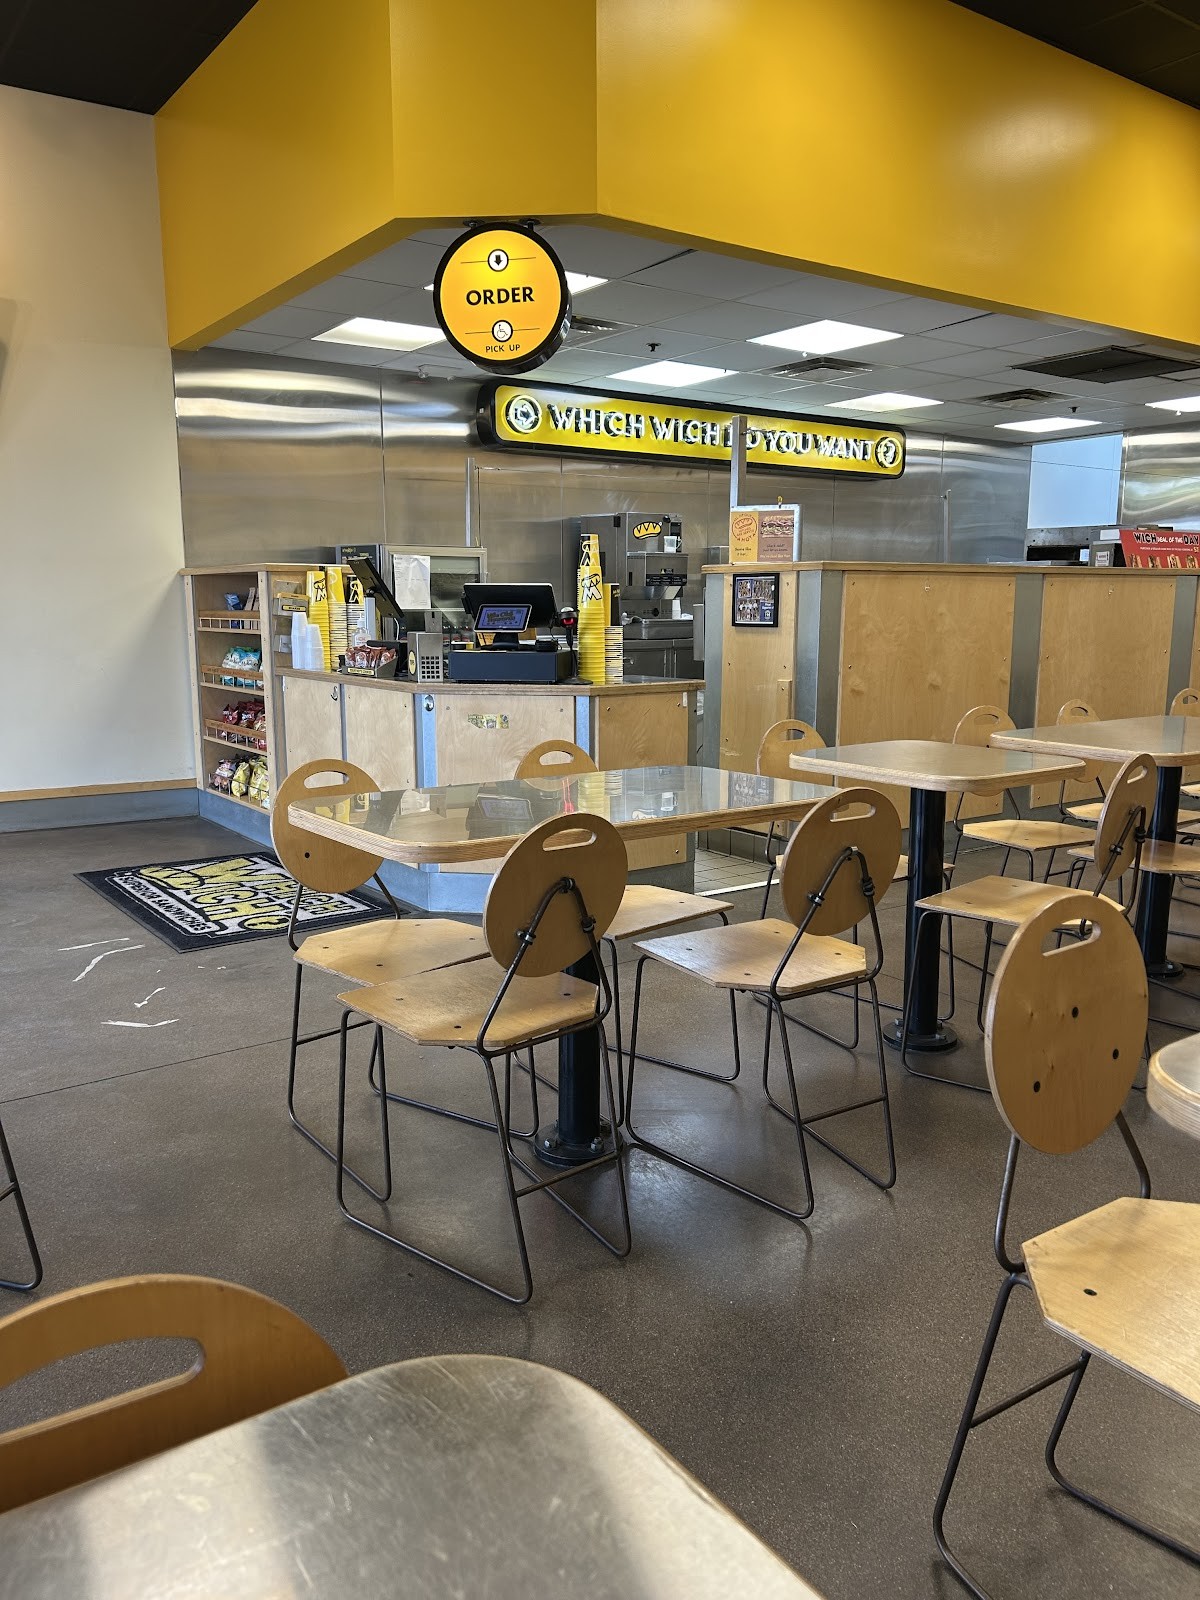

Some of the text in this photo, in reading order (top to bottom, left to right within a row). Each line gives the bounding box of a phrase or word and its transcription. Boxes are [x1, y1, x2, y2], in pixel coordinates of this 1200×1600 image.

[466, 286, 535, 306] ORDER
[485, 344, 521, 353] PICK UP
[546, 403, 646, 439] WHICH
[648, 415, 720, 446] WICH
[763, 429, 812, 455] YOU
[813, 434, 873, 460] WANT
[1133, 532, 1158, 544] WICH
[1183, 534, 1200, 545] DAY
[119, 876, 211, 931] SUPERIOR SANDWICHES
